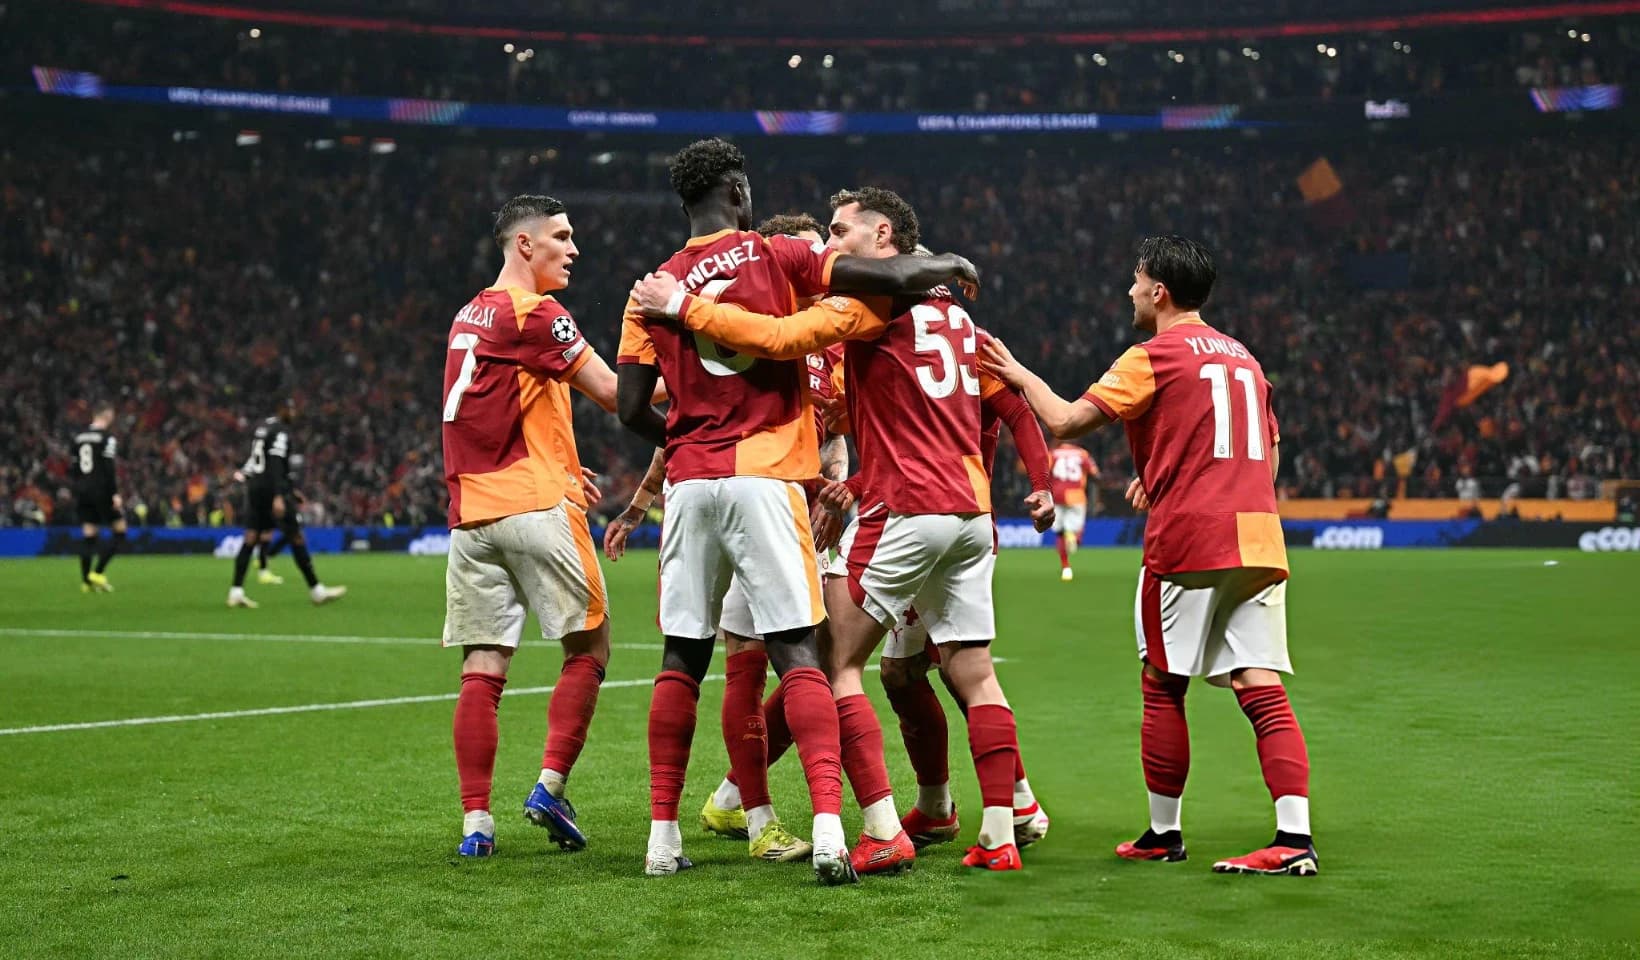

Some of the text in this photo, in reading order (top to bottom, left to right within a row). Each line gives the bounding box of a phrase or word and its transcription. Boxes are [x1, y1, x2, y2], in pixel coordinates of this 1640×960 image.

[201, 89, 279, 110] CHAMPIONS
[918, 112, 1099, 130] UEFA CHAMPIONS LEAGUE
[683, 240, 760, 291] NCHEZ
[911, 304, 980, 399] 53
[1184, 336, 1248, 359] YUNUS
[443, 333, 480, 422] 7
[1199, 363, 1264, 460] 11
[79, 443, 94, 474] 8
[1053, 454, 1083, 482] 45
